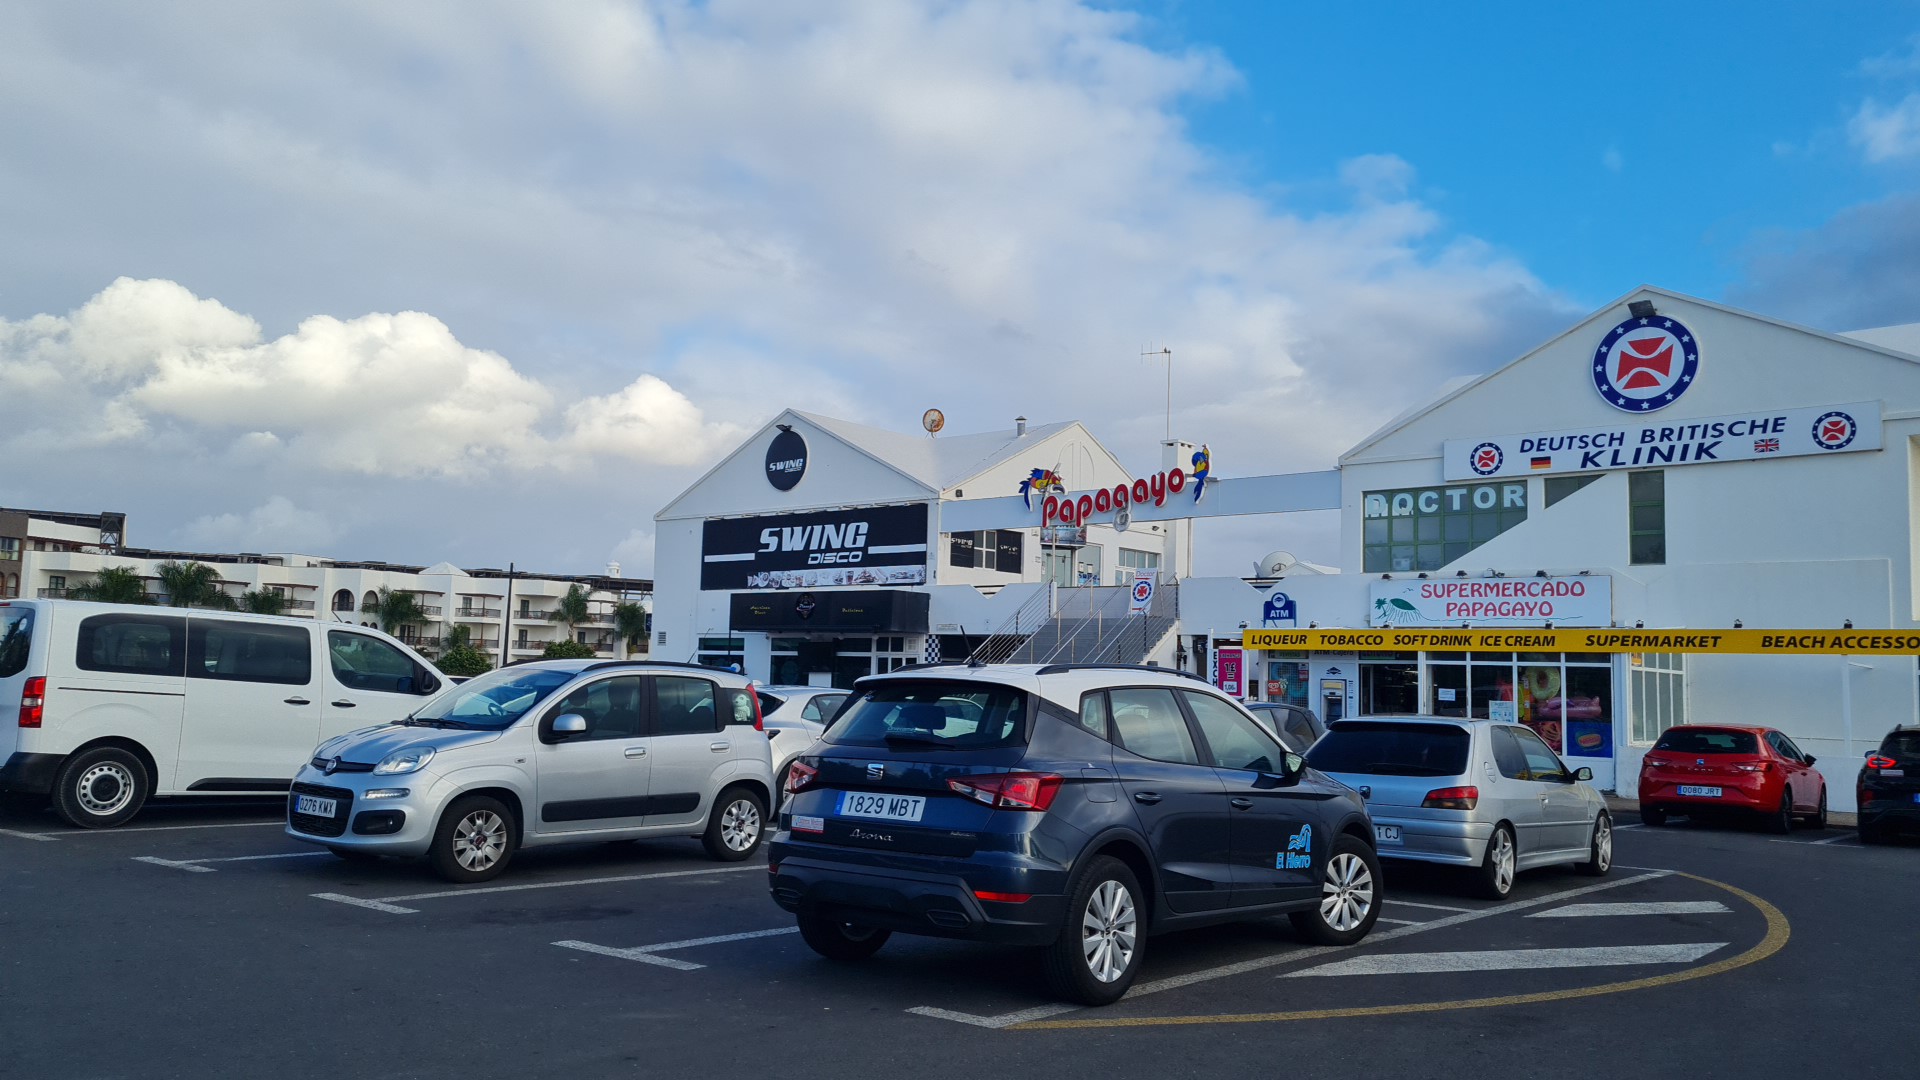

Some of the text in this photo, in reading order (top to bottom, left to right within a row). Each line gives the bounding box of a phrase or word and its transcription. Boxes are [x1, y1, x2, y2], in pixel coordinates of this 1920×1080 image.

[1520, 416, 1787, 453] DEUTSCH BRITISCHE
[1580, 441, 1723, 468] KLINIK
[769, 458, 803, 471] SWING
[1366, 485, 1525, 515] DOCTOR
[758, 521, 869, 553] SWING
[807, 551, 863, 565] DISCO
[1420, 580, 1586, 599] SUPERMERCADO
[1269, 609, 1289, 618] ATM
[1446, 601, 1553, 617] PAPAGAYO
[1251, 634, 1920, 649] LIQUEUR TOBACCO SOFT DRINK ICE CREAM SUPERMARKET BEACH ACCESSO
[1705, 787, 1721, 795] JRT
[300, 797, 334, 815] 0276 KMX
[847, 795, 921, 817] 1829 MBT
[849, 828, 894, 842] Arona
[1385, 827, 1399, 840] CJ
[1276, 851, 1311, 869] El Hierro
